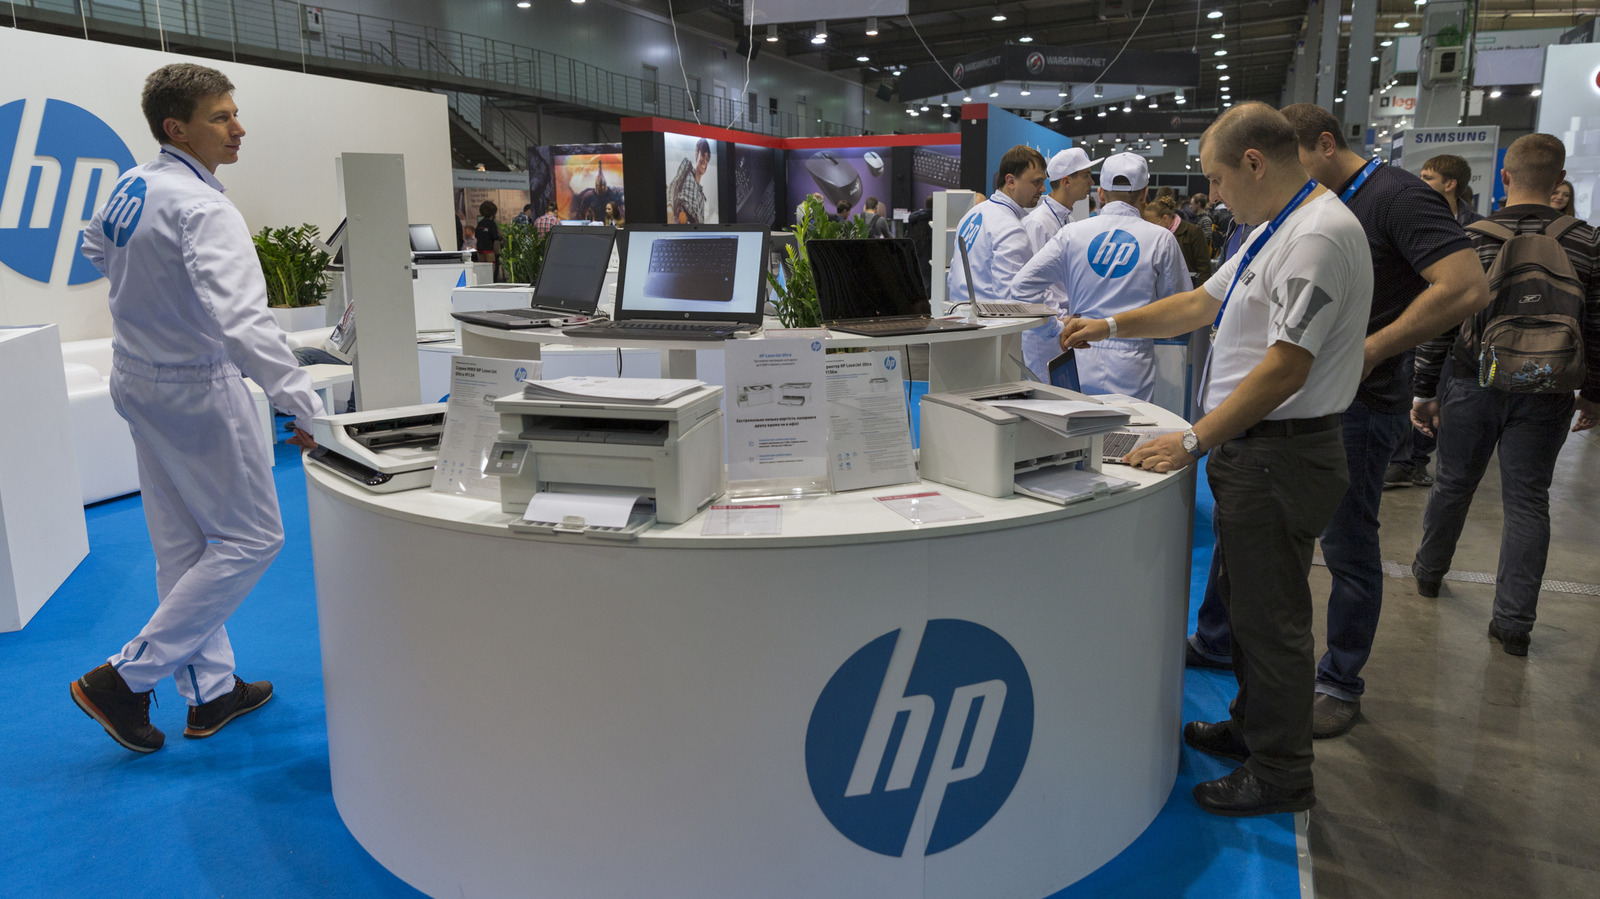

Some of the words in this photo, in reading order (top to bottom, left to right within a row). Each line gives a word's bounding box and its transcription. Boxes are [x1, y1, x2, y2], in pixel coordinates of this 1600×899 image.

[1046, 55, 1107, 67] WARGAMING.NET
[1415, 131, 1487, 144] SAMSUNG
[0, 98, 119, 285] hp
[103, 176, 143, 247] hp
[1091, 228, 1137, 279] hp
[514, 367, 528, 383] hp
[884, 356, 897, 371] hp
[843, 620, 1008, 857] hp
